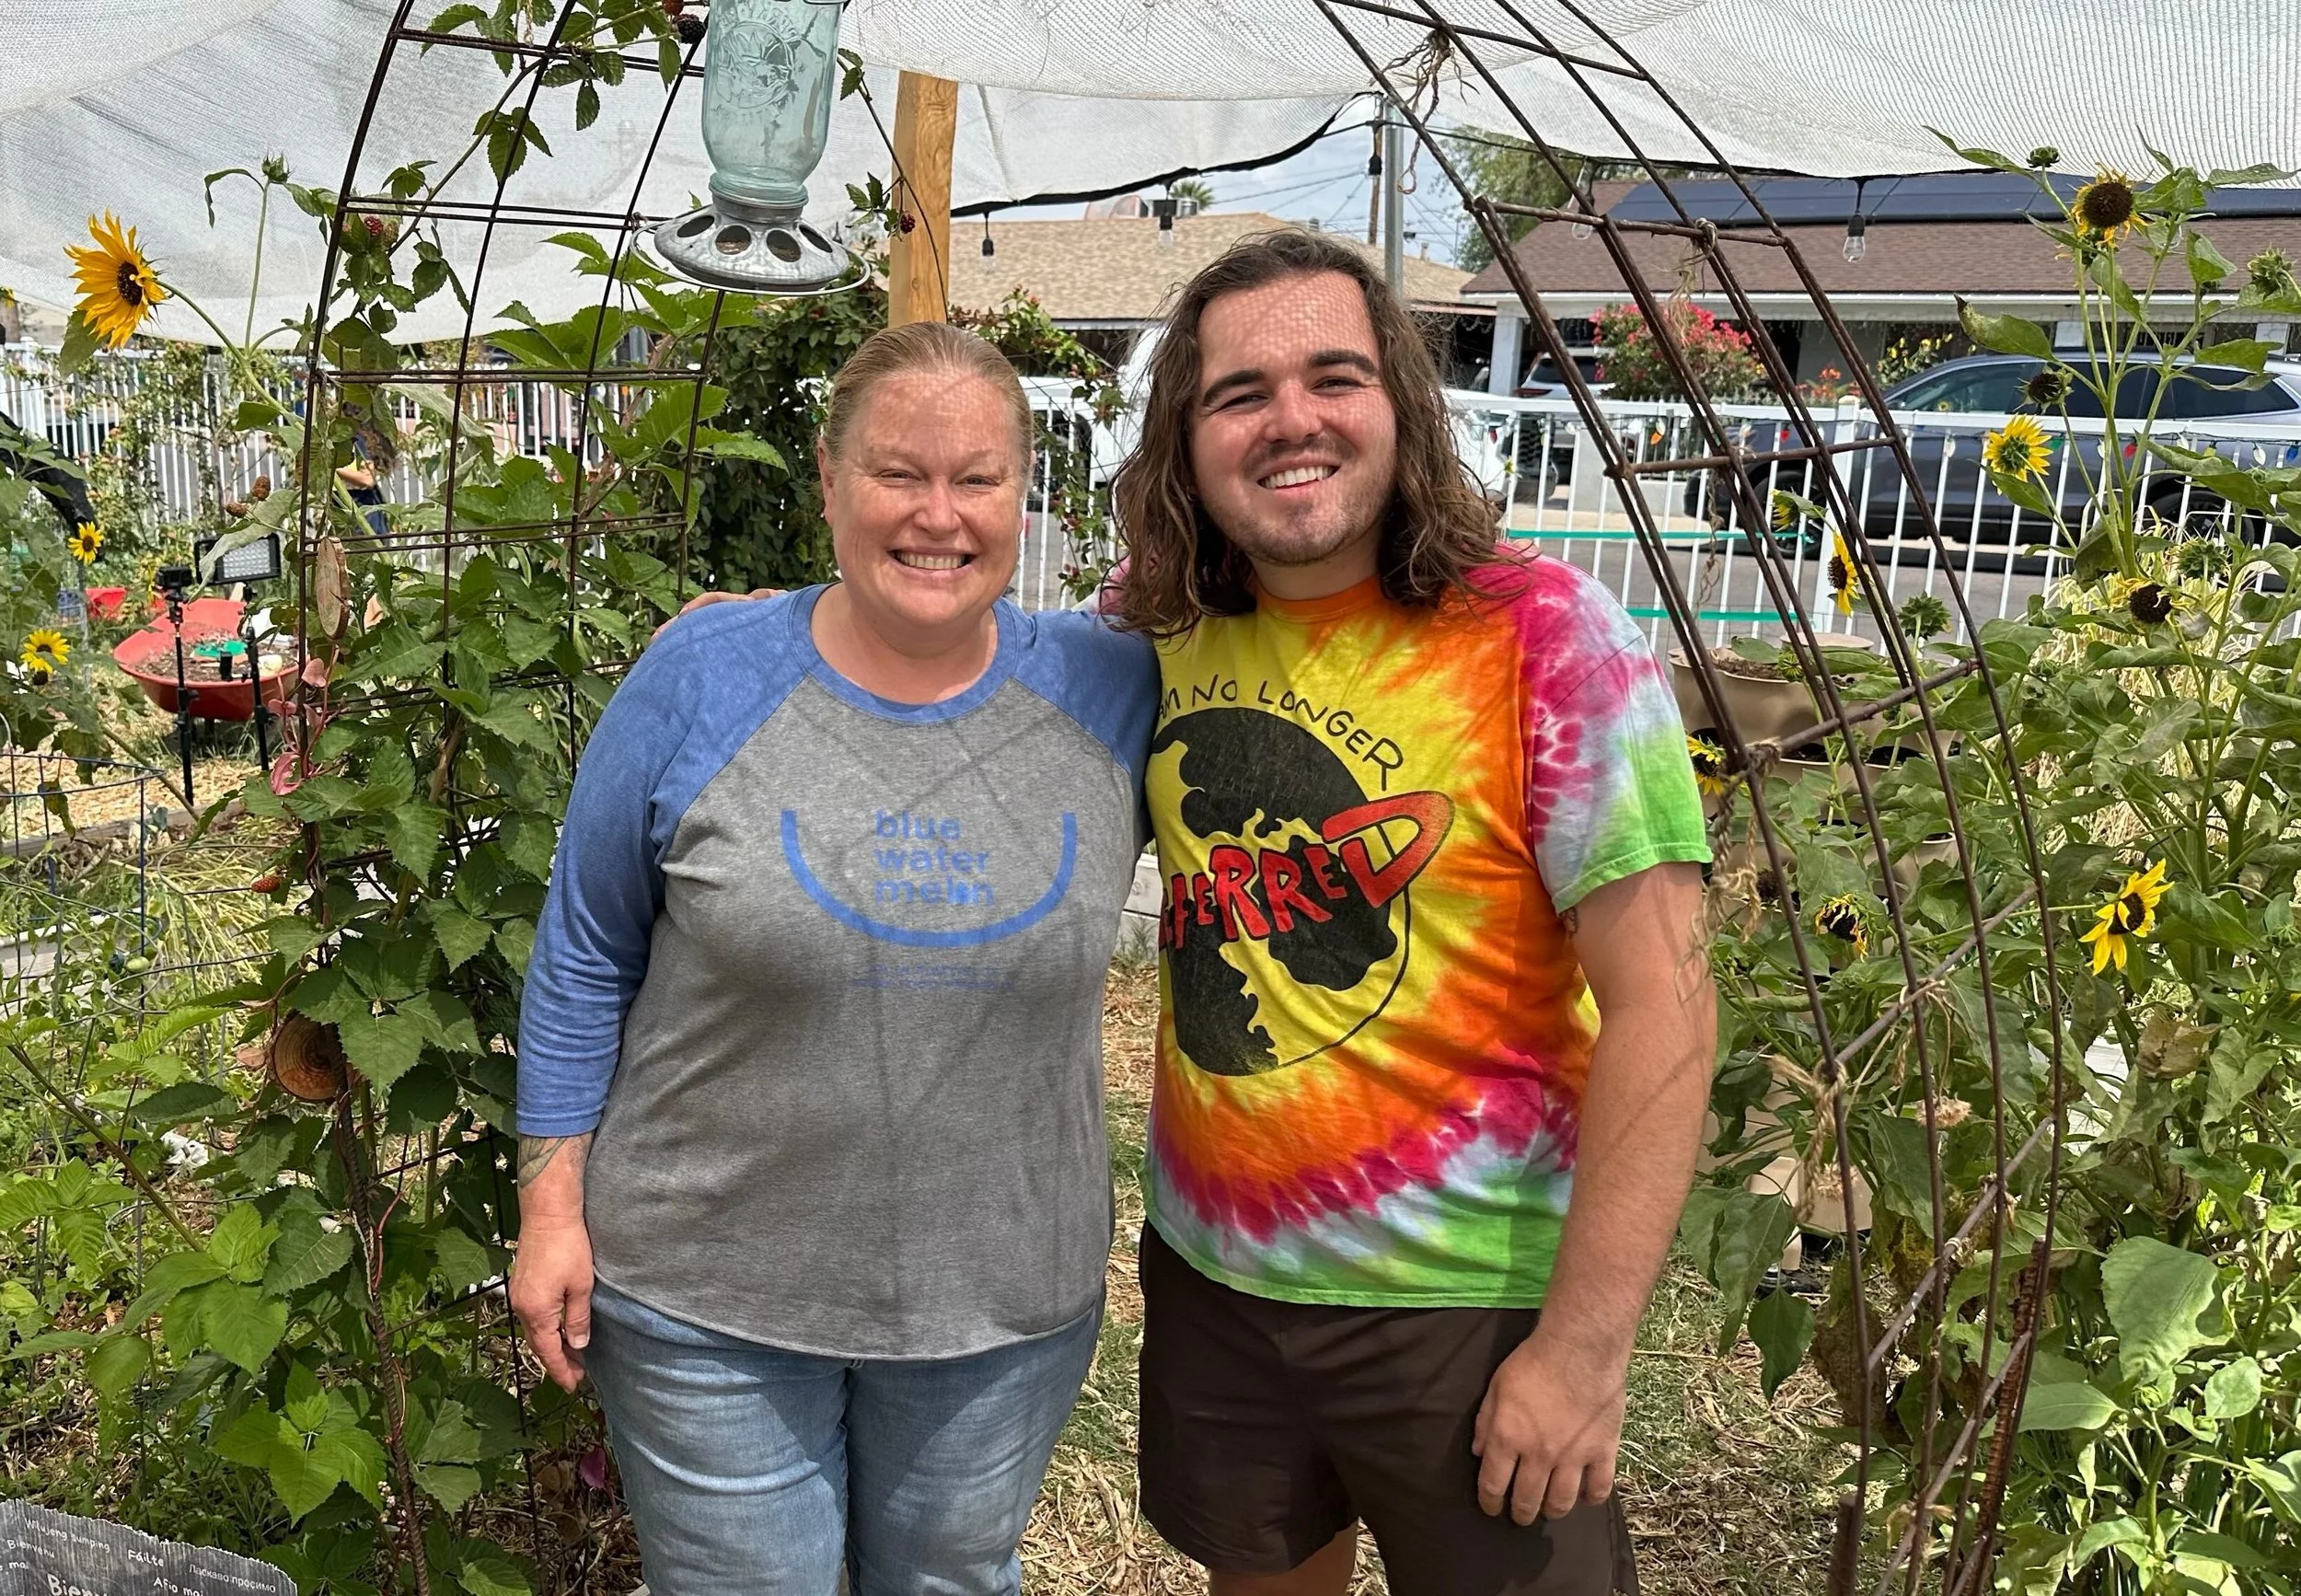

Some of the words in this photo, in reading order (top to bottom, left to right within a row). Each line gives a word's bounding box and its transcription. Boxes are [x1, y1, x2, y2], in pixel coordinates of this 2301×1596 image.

[1192, 674, 1238, 706] NO
[1257, 681, 1404, 792] LONGER
[875, 809, 961, 840] blue
[874, 847, 989, 873] water
[7, 1539, 55, 1559] Bienvenu
[128, 1549, 165, 1567] Fáilte
[231, 1576, 276, 1593] просимо
